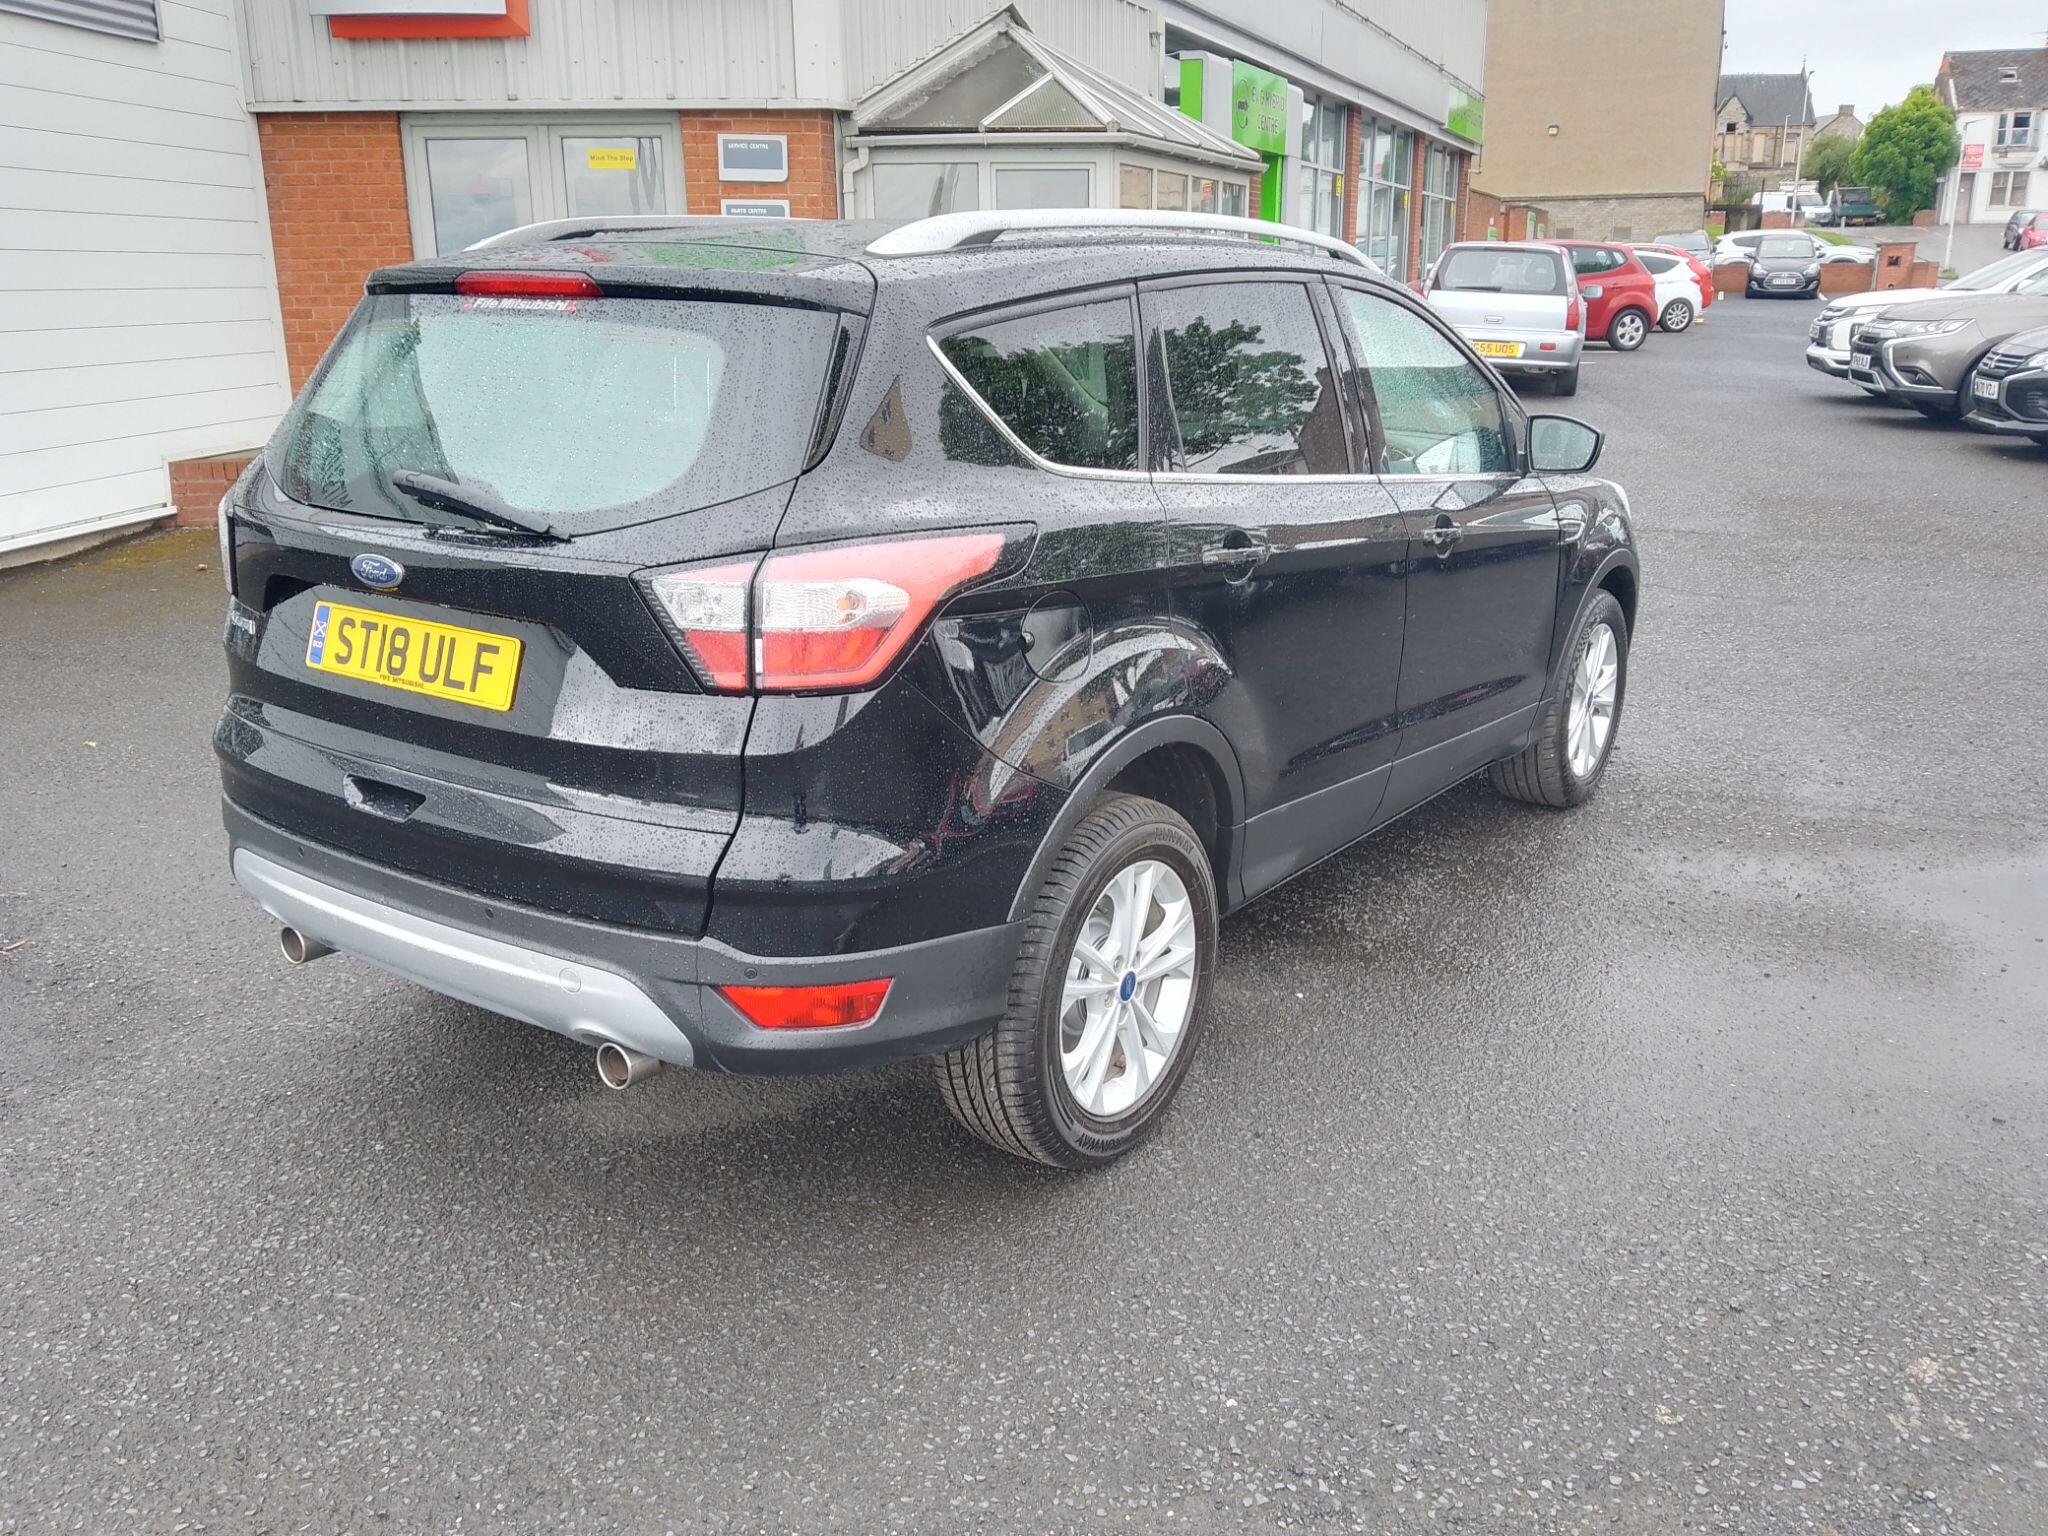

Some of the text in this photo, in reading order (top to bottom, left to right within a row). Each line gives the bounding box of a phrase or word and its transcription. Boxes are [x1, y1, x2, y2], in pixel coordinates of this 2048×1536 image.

[1265, 91, 1284, 112] HYBRID
[1257, 113, 1279, 135] CENTRE
[621, 154, 634, 162] Step
[473, 297, 569, 311] Fife Mitsubishi
[334, 616, 500, 693] ST18 ULF
